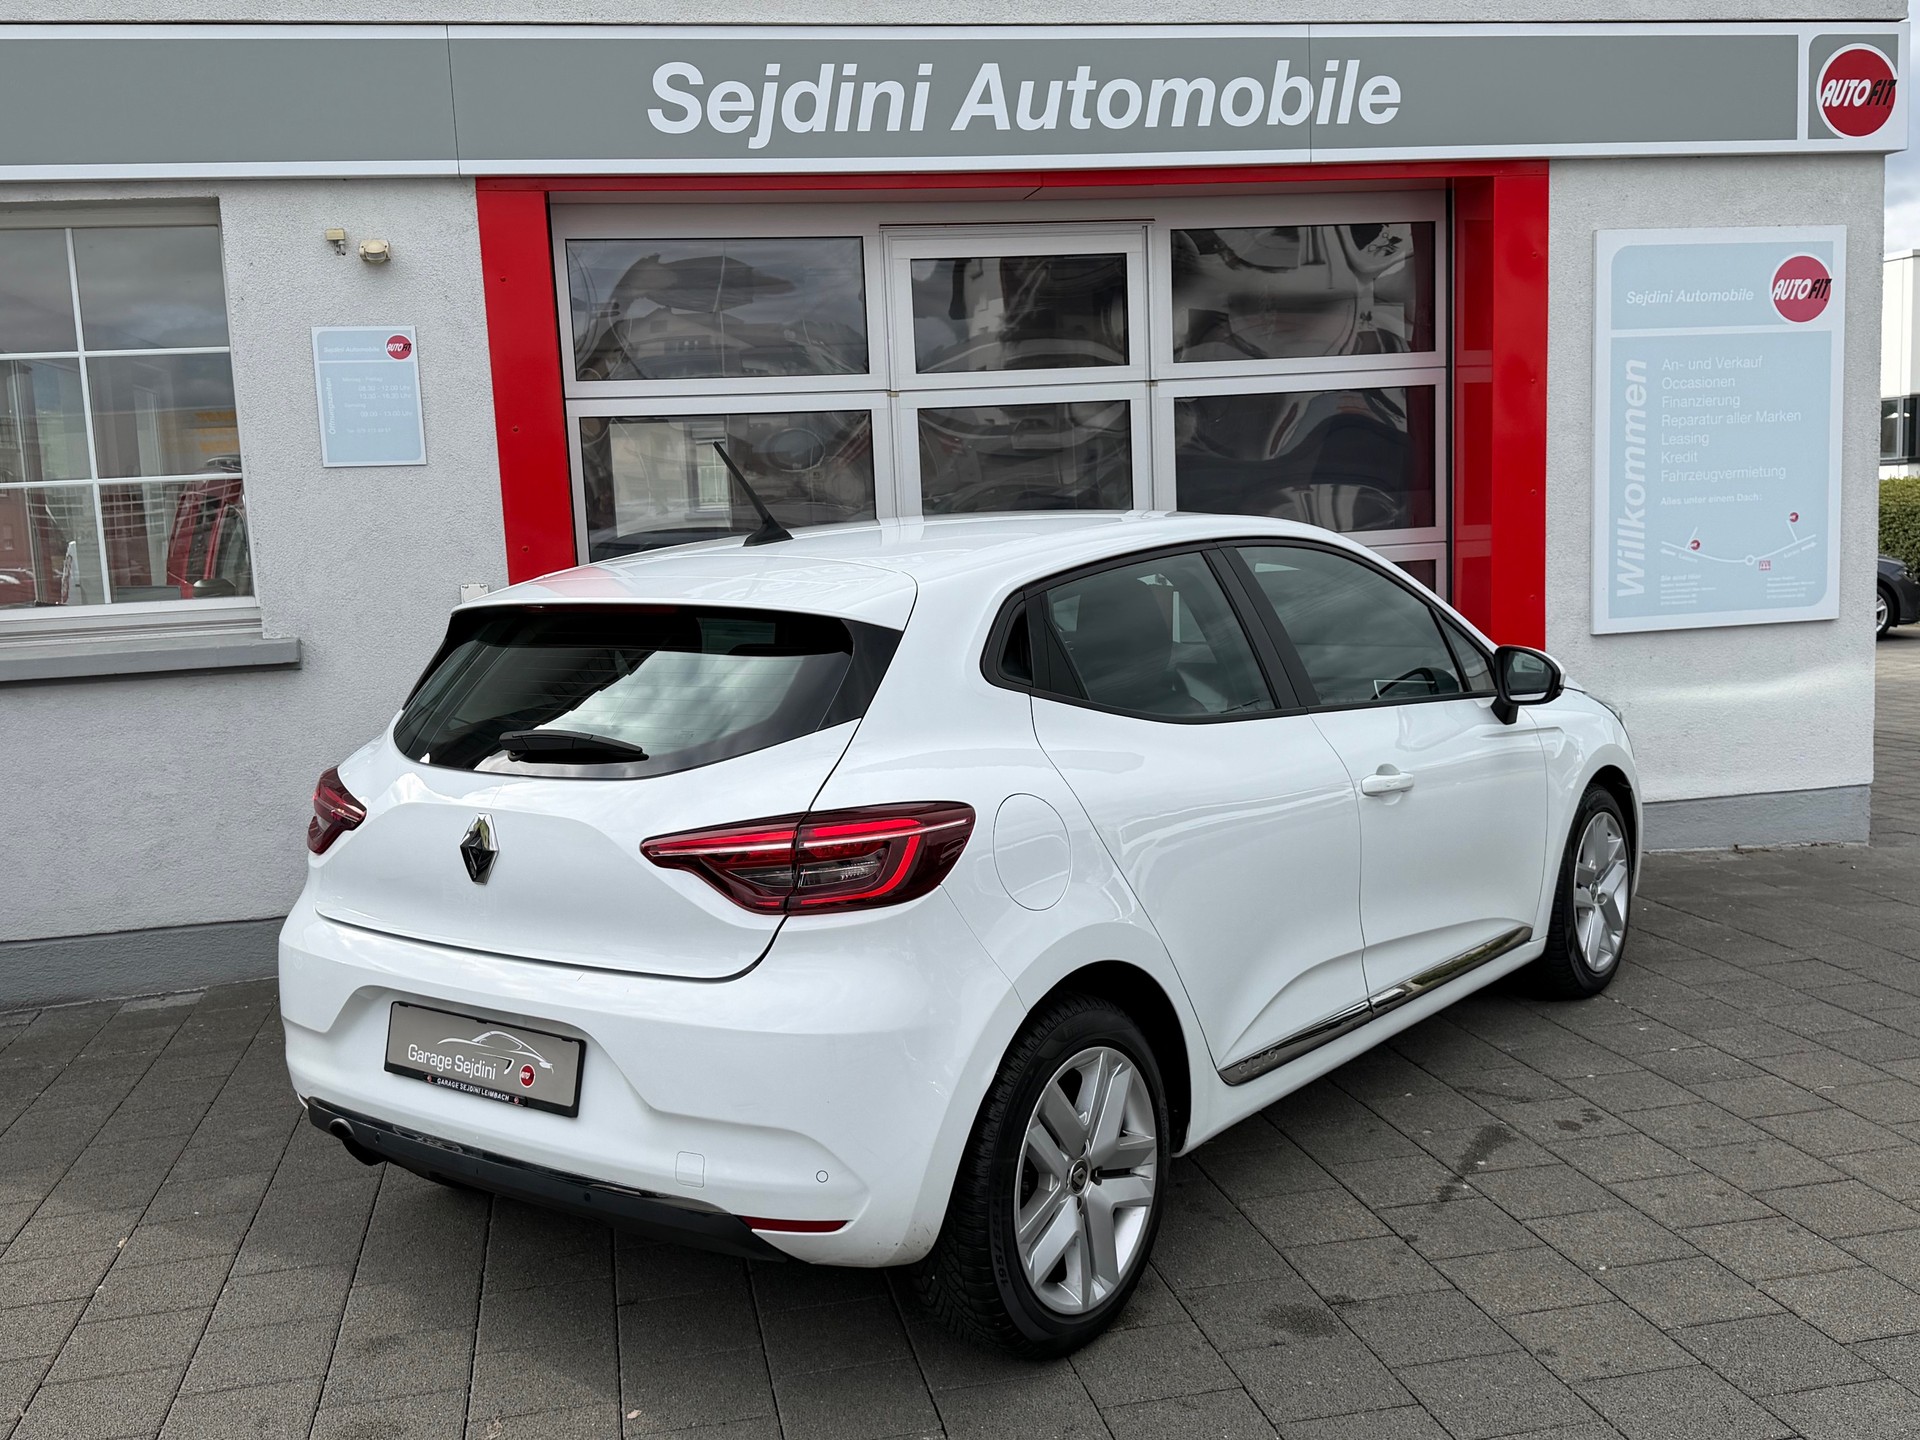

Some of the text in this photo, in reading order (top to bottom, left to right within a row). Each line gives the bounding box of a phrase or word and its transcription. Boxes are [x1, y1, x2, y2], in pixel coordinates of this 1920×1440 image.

[647, 60, 1402, 149] Sejdini Automobile
[1626, 287, 1755, 306] Sejdini Automobile
[1661, 355, 1763, 371] An- und Verkauf
[1661, 376, 1736, 390] Occasionen
[1661, 394, 1741, 409] Finanzierung
[1661, 410, 1802, 430] Reparatur aller Marken
[1661, 432, 1710, 447] Leasing
[1660, 451, 1698, 465] Kredit
[1617, 359, 1647, 598] Willkommen
[1660, 465, 1787, 483] Fahrzeugvermietung
[1660, 496, 1682, 506] Alles
[1708, 494, 1735, 504] einem
[408, 1044, 497, 1080] Garage Sejdini
[437, 1077, 459, 1089] GARAGE
